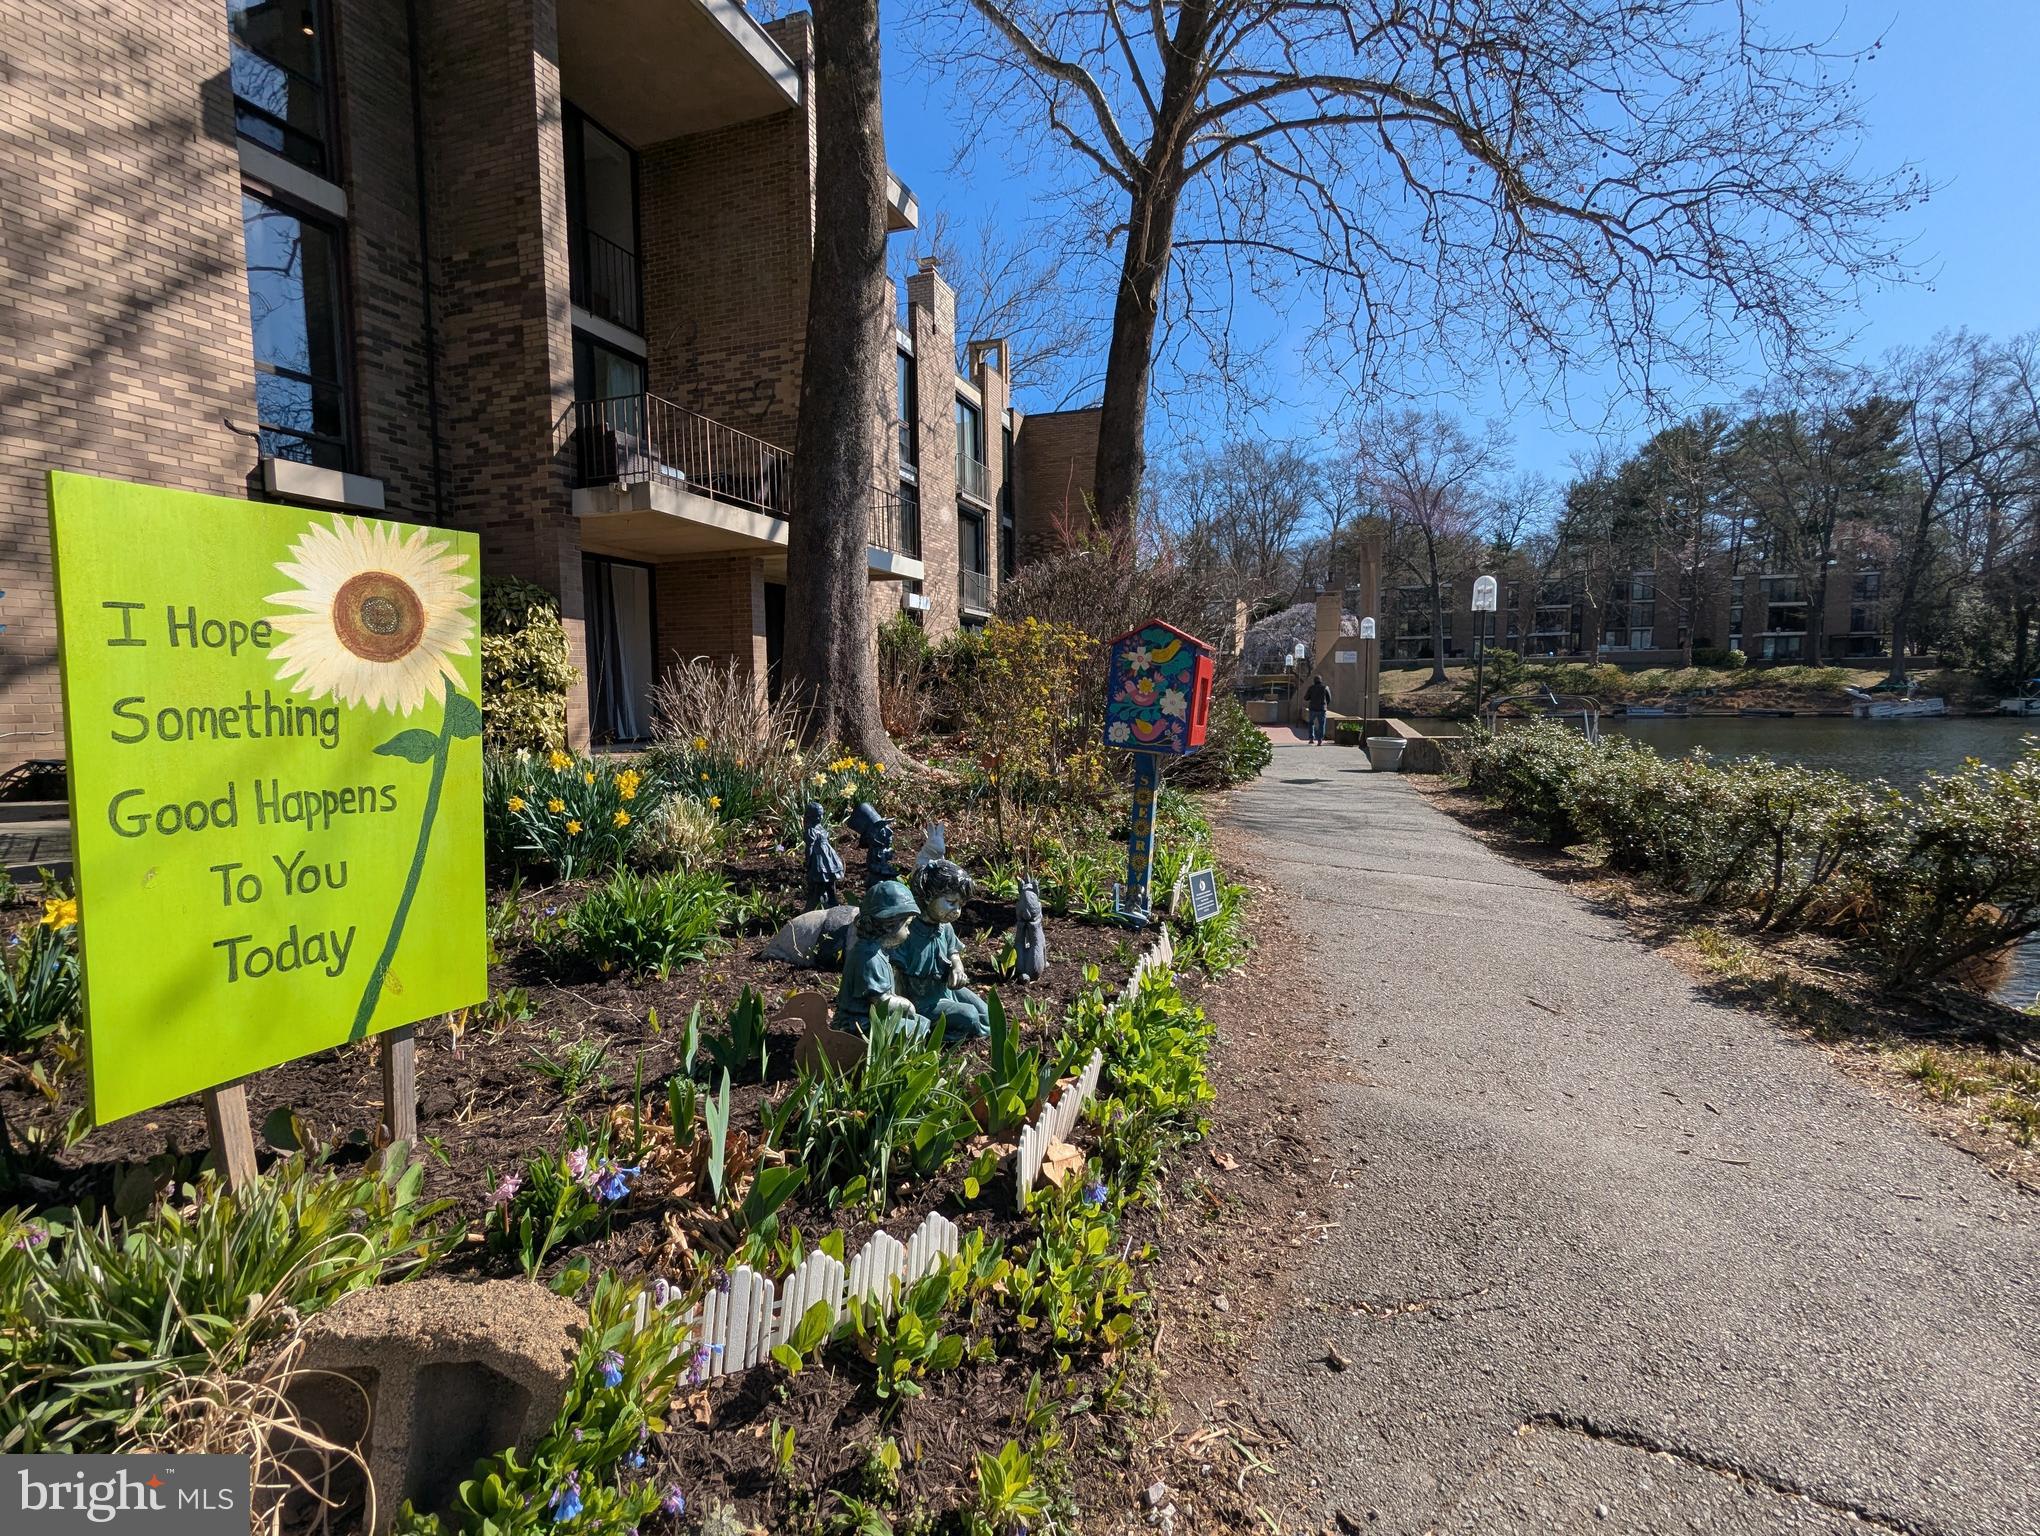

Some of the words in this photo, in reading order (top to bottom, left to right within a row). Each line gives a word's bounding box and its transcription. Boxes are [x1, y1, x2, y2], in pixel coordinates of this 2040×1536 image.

[103, 601, 146, 647] I
[168, 605, 272, 656] Hope
[112, 690, 340, 749] Something
[109, 781, 238, 837] Good
[255, 779, 397, 832] Happens
[210, 863, 262, 906] To
[272, 850, 348, 895] You
[213, 925, 356, 983] Today
